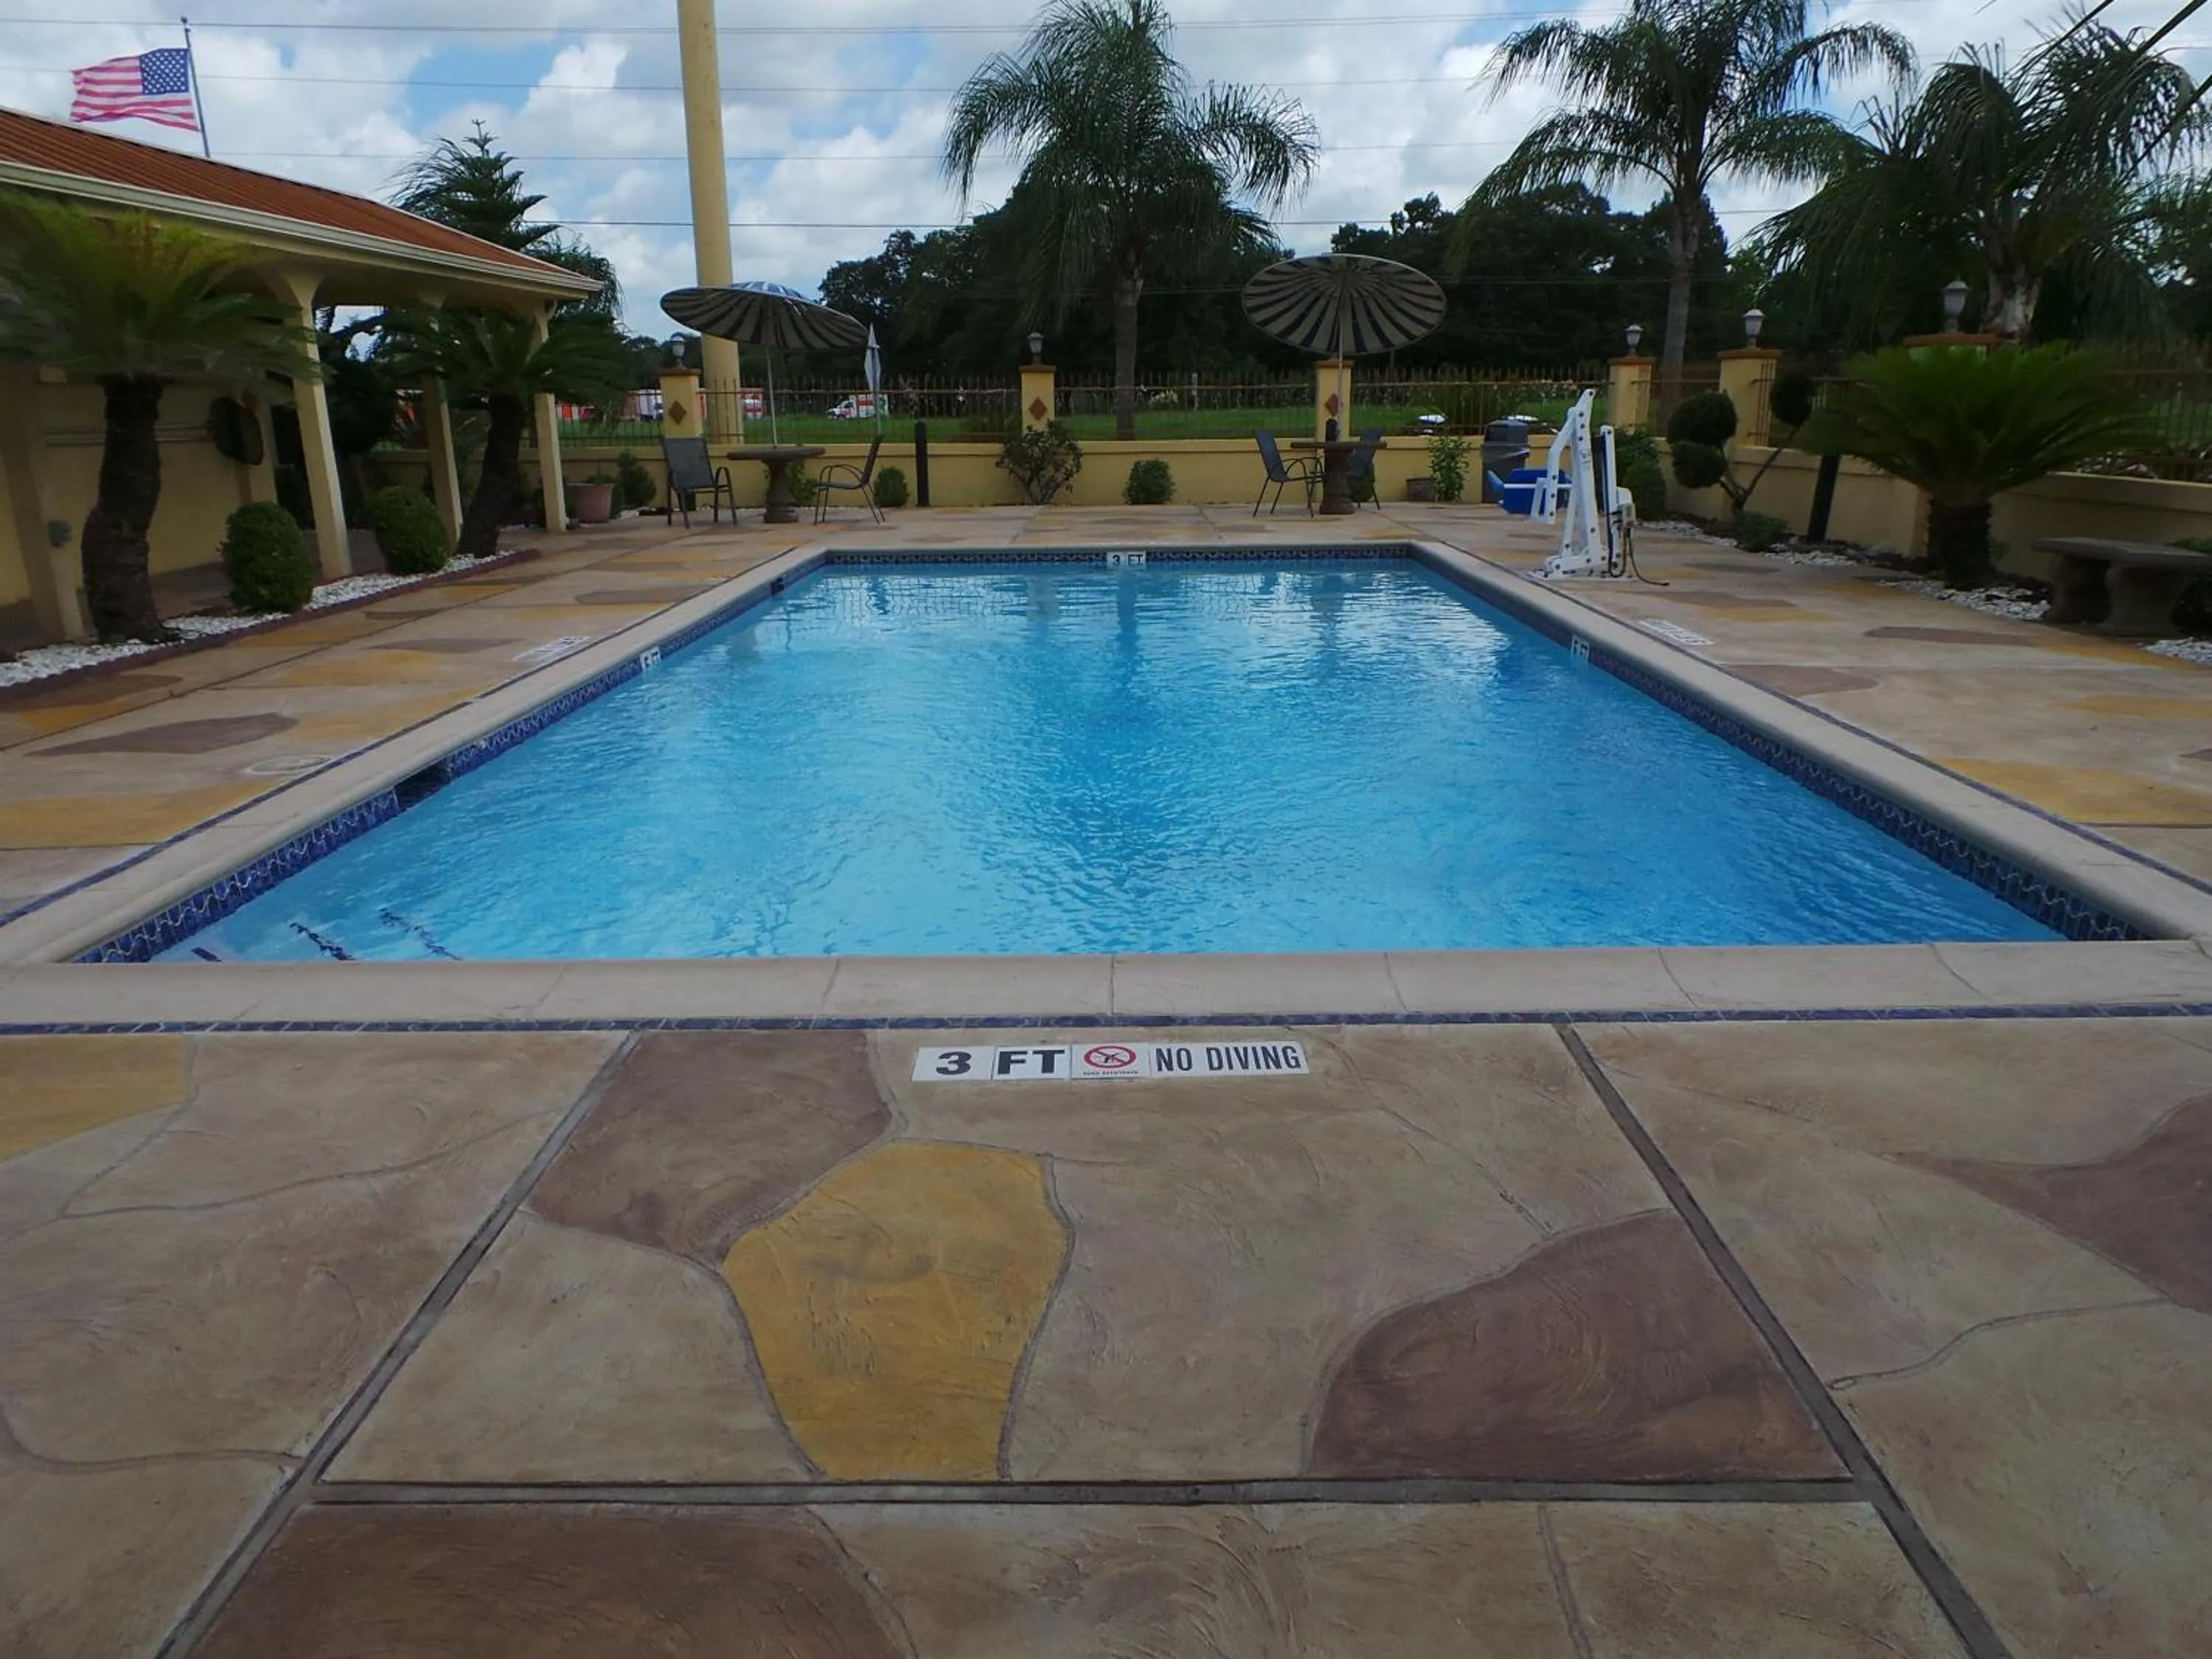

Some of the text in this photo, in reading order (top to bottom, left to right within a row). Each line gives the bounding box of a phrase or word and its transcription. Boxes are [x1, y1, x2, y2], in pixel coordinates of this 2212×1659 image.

[936, 1049, 1065, 1076] 3 FT
[1155, 1045, 1301, 1072] NO DIVING
